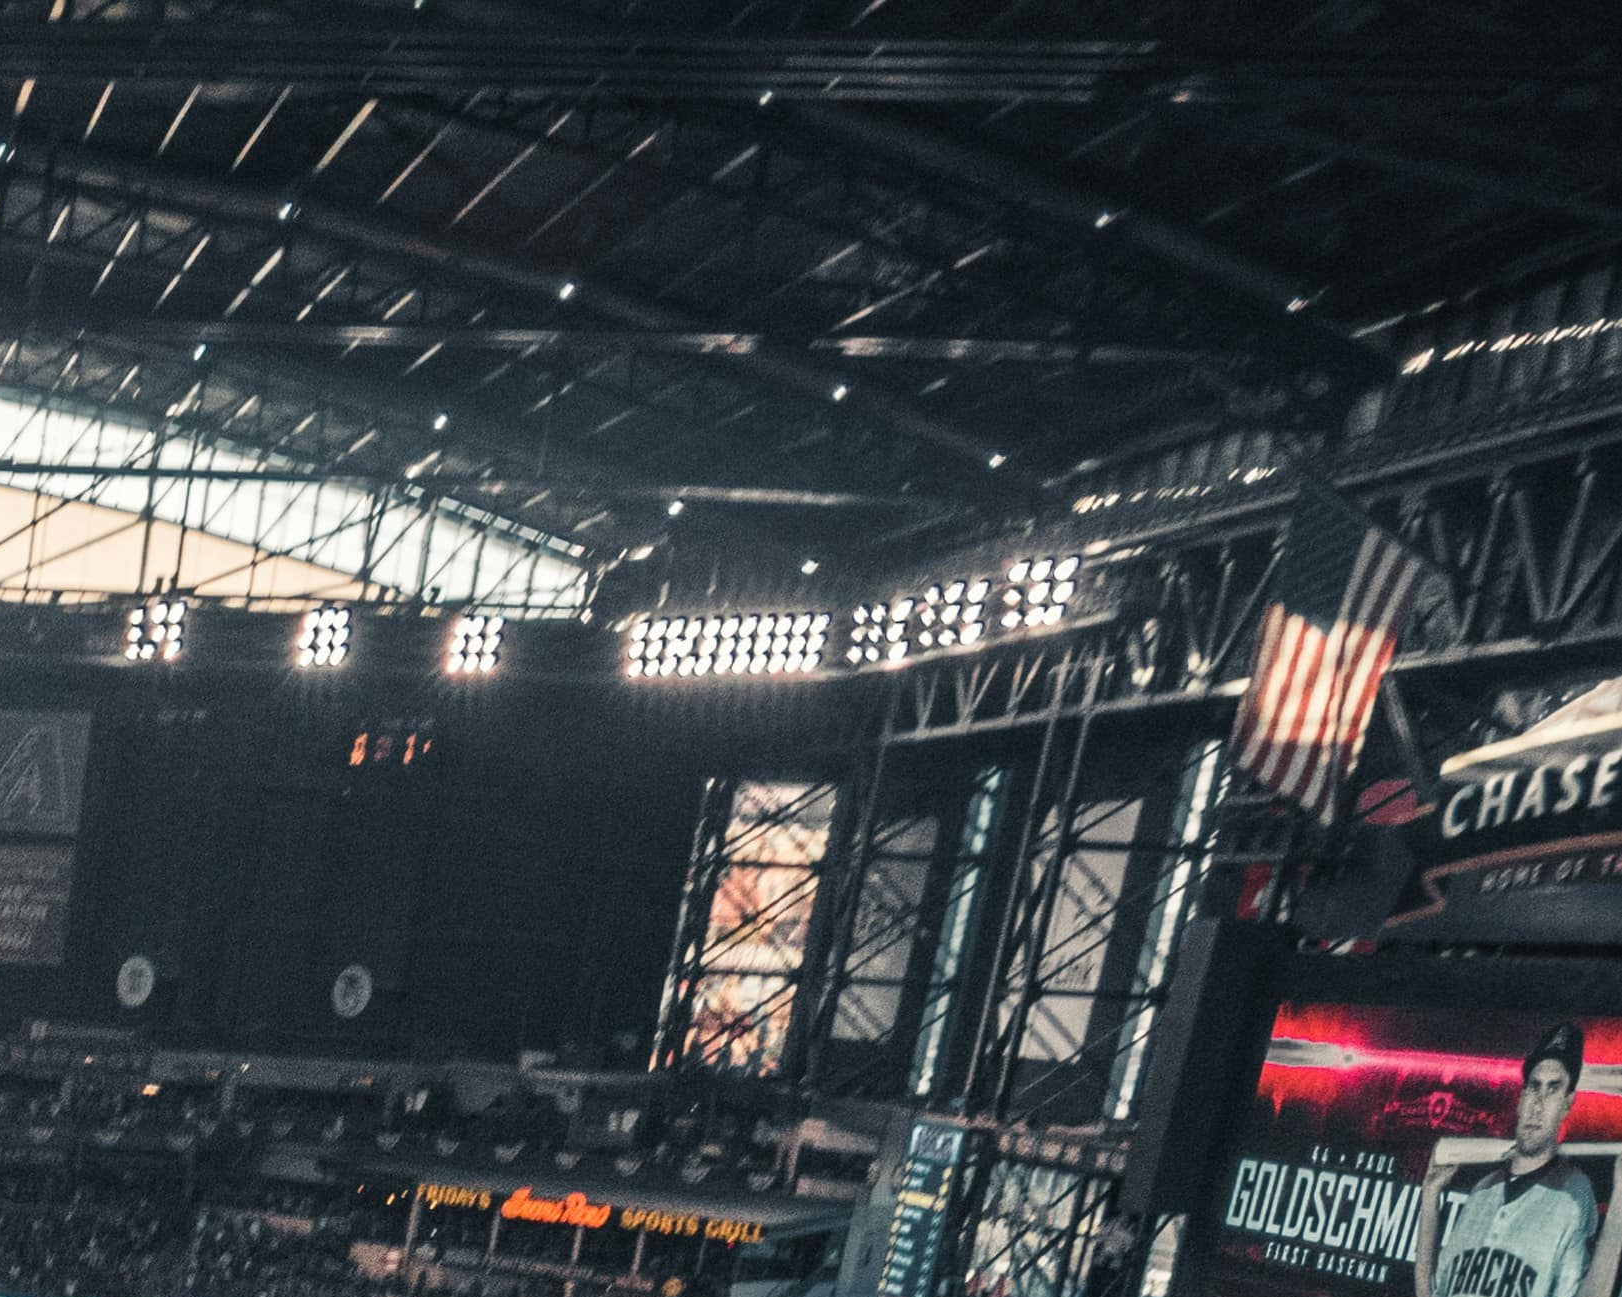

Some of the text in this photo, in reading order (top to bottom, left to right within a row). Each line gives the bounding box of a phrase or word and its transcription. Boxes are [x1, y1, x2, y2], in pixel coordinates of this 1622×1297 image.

[1441, 748, 1622, 840] CHASE
[1480, 861, 1545, 894] HOME
[1555, 857, 1587, 883] OF
[1355, 1152, 1396, 1175] PAUL
[619, 1206, 700, 1236] SPORTS
[704, 1218, 763, 1244] GRILL
[1265, 1241, 1390, 1284] FIRST BASEMAN
